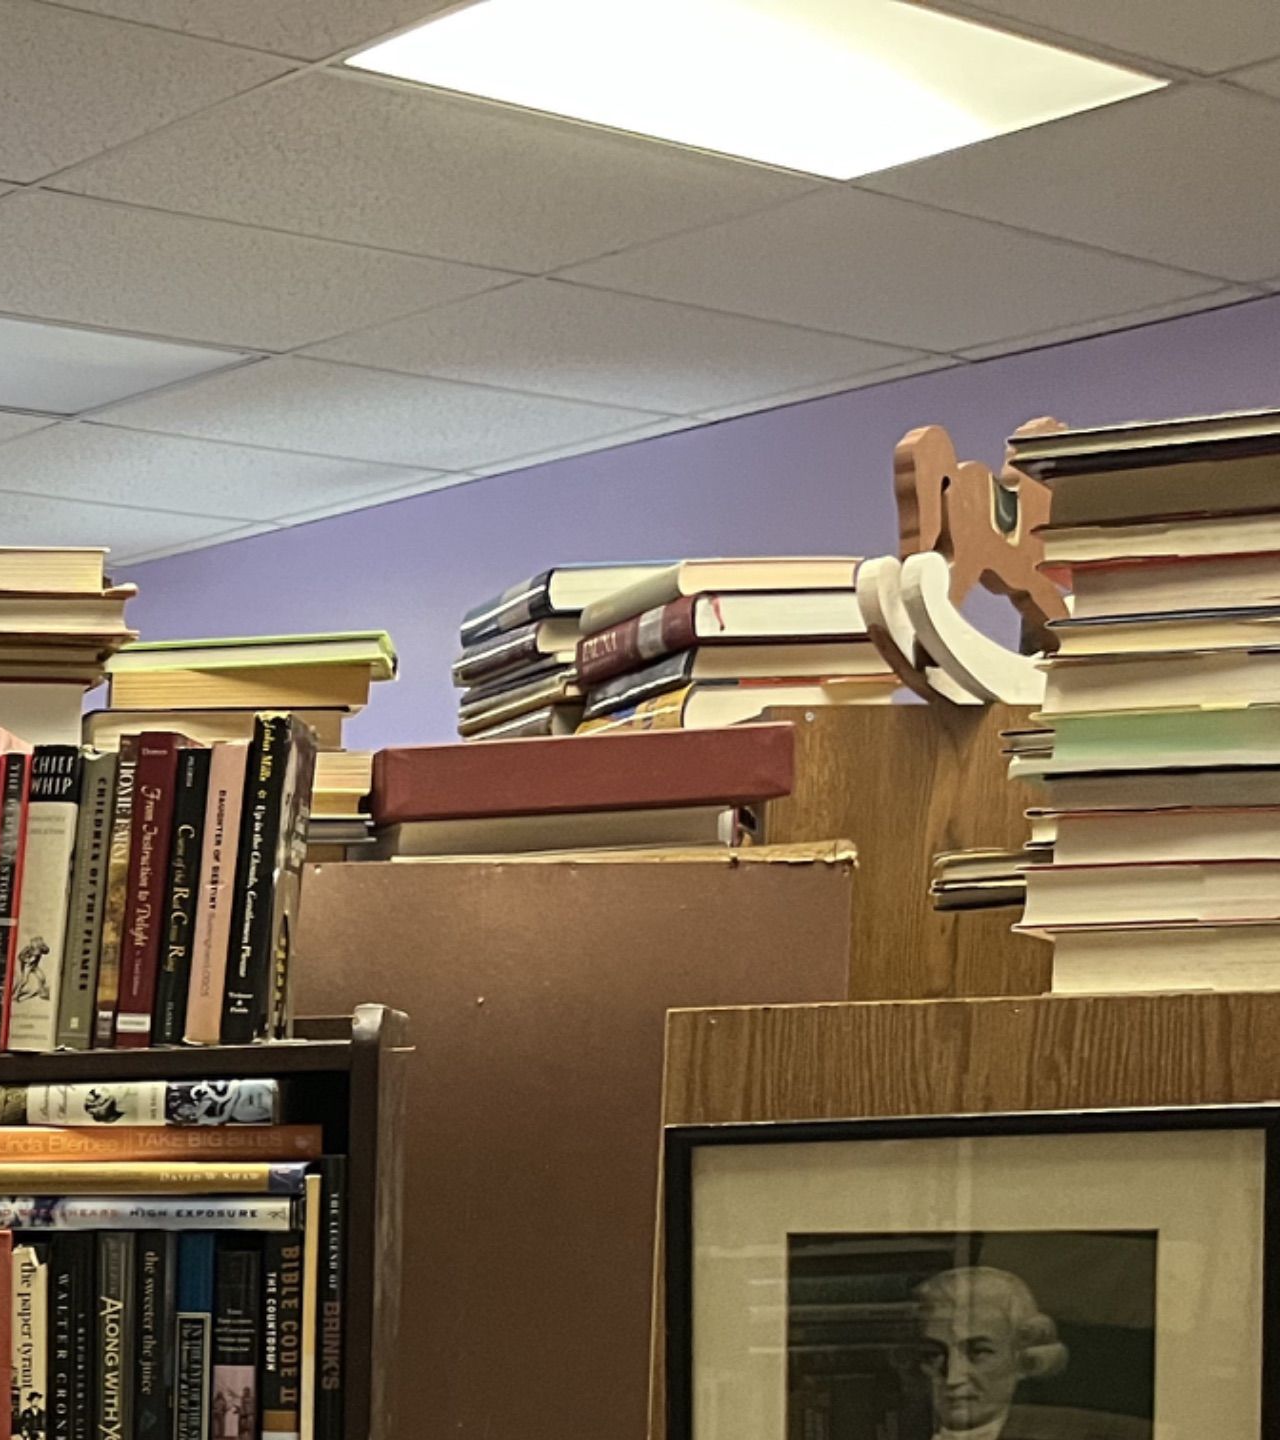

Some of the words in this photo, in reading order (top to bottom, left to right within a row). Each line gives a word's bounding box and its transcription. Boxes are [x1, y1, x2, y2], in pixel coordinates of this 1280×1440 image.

[31, 778, 74, 795] WHIP
[32, 756, 74, 775] CHIEF
[116, 760, 136, 814] HOME
[259, 755, 274, 782] Mills
[90, 778, 107, 860] CHILDREN
[140, 786, 161, 821] From
[214, 790, 226, 846] DAUGHTER
[138, 823, 159, 888] Instruction
[129, 903, 150, 946] Delight
[79, 930, 94, 991] FLAMES
[136, 1132, 184, 1148] TAKE
[187, 1133, 223, 1147] BIG
[21, 1262, 35, 1288] the
[143, 1251, 157, 1273] the
[281, 1246, 299, 1309] BIBLE
[18, 1292, 34, 1339] paper
[56, 1274, 69, 1359] WALTER
[141, 1278, 156, 1329] sweeter
[99, 1296, 124, 1366] ALONG
[142, 1335, 157, 1356] the
[280, 1321, 297, 1377] CODE
[322, 1301, 340, 1390] BRINK'S
[17, 1343, 34, 1390] tyrant
[140, 1360, 157, 1394] juice
[104, 1371, 120, 1420] WITH
